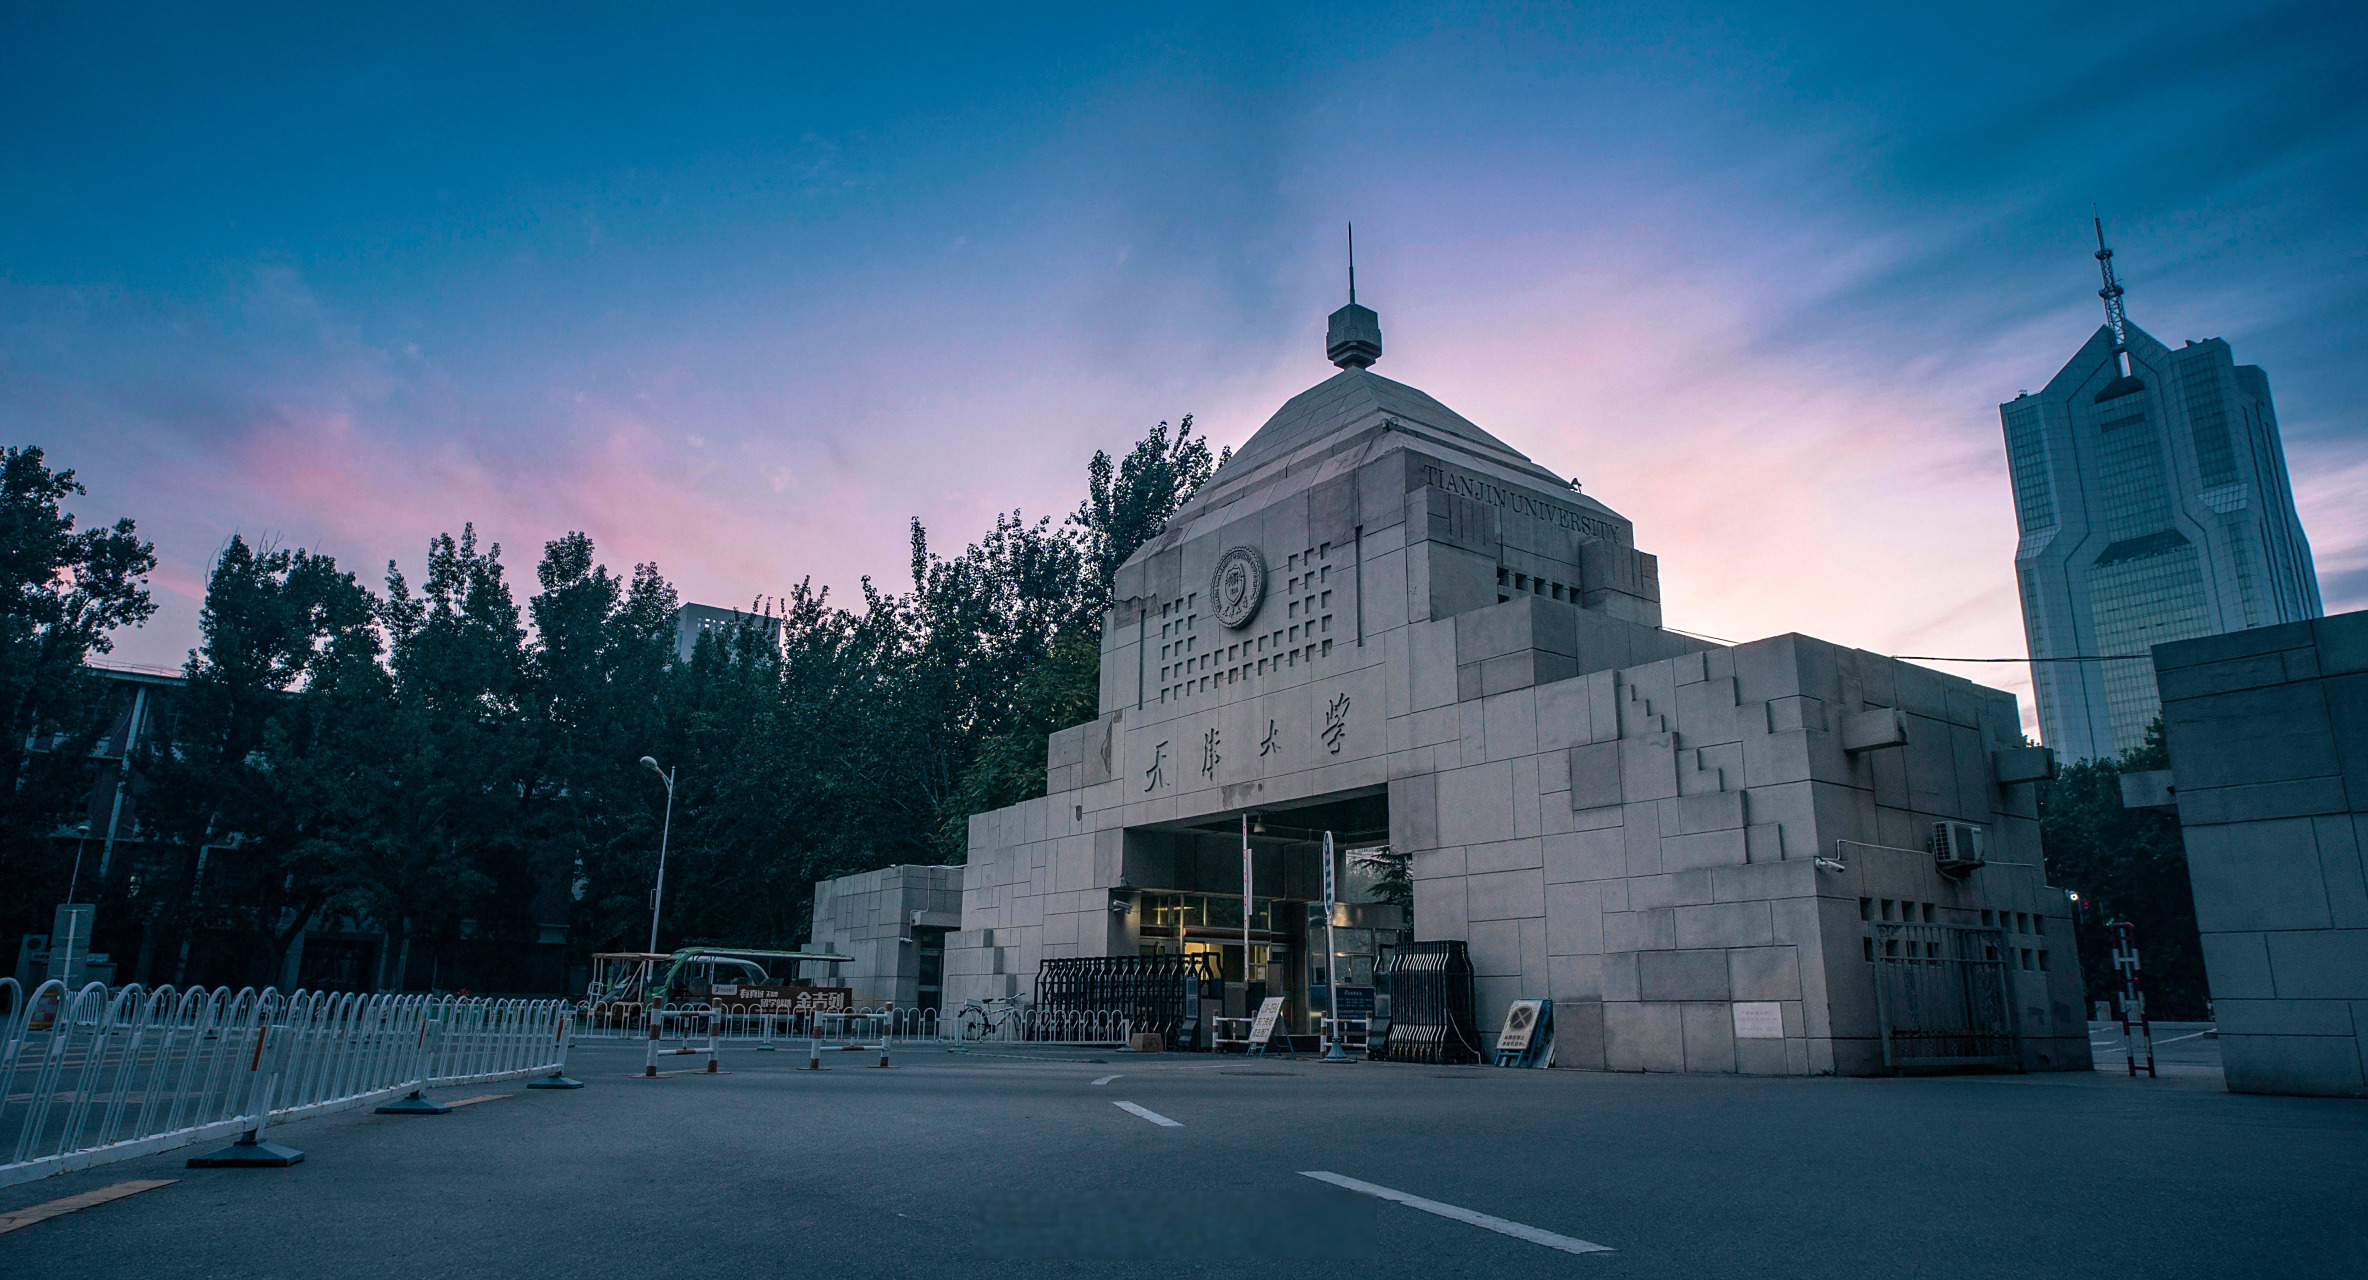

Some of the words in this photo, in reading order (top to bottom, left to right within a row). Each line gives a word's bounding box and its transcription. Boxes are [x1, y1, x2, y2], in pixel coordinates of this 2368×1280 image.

[1423, 464, 1506, 509] TIANJIN
[1509, 492, 1620, 544] UNIVERSITY
[796, 991, 845, 1010] 金吉列
